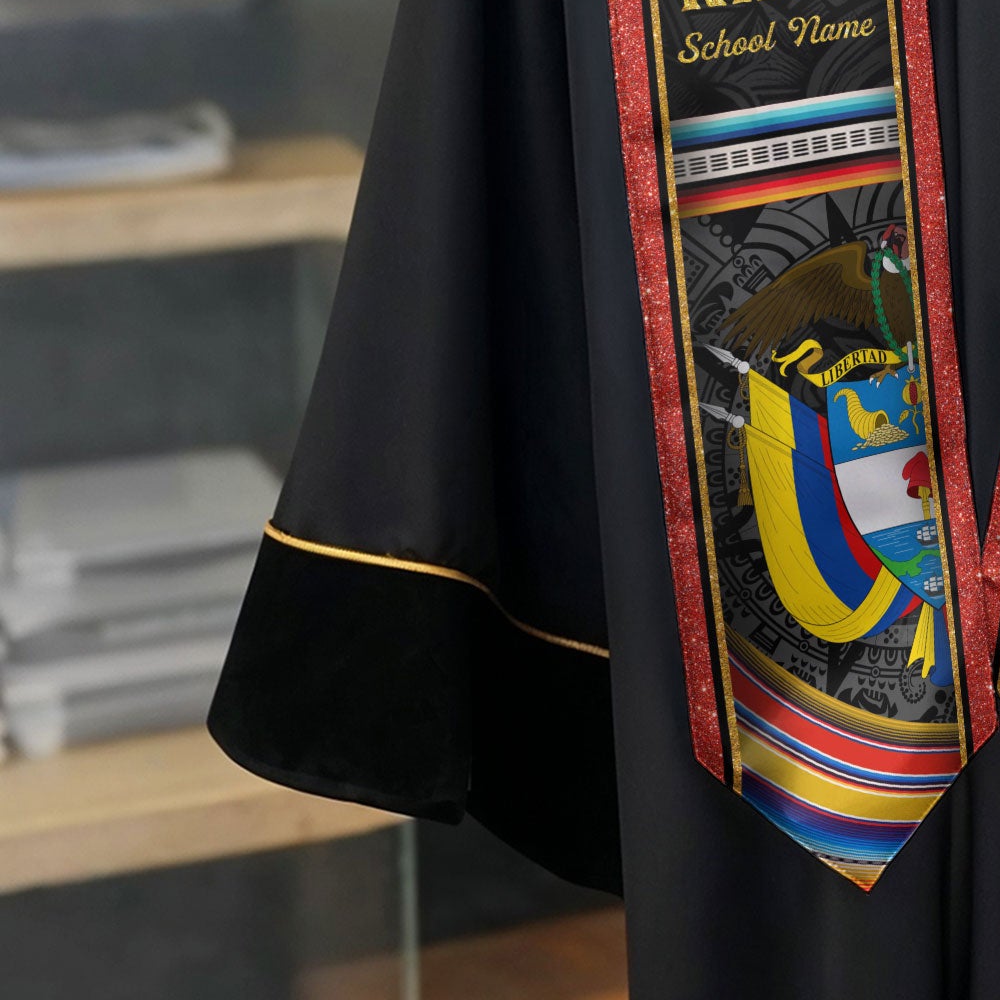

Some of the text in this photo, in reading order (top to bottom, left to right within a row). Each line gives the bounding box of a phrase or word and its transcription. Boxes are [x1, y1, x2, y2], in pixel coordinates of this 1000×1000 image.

[677, 14, 876, 64] School Name
[821, 349, 887, 387] LIBERTAD
